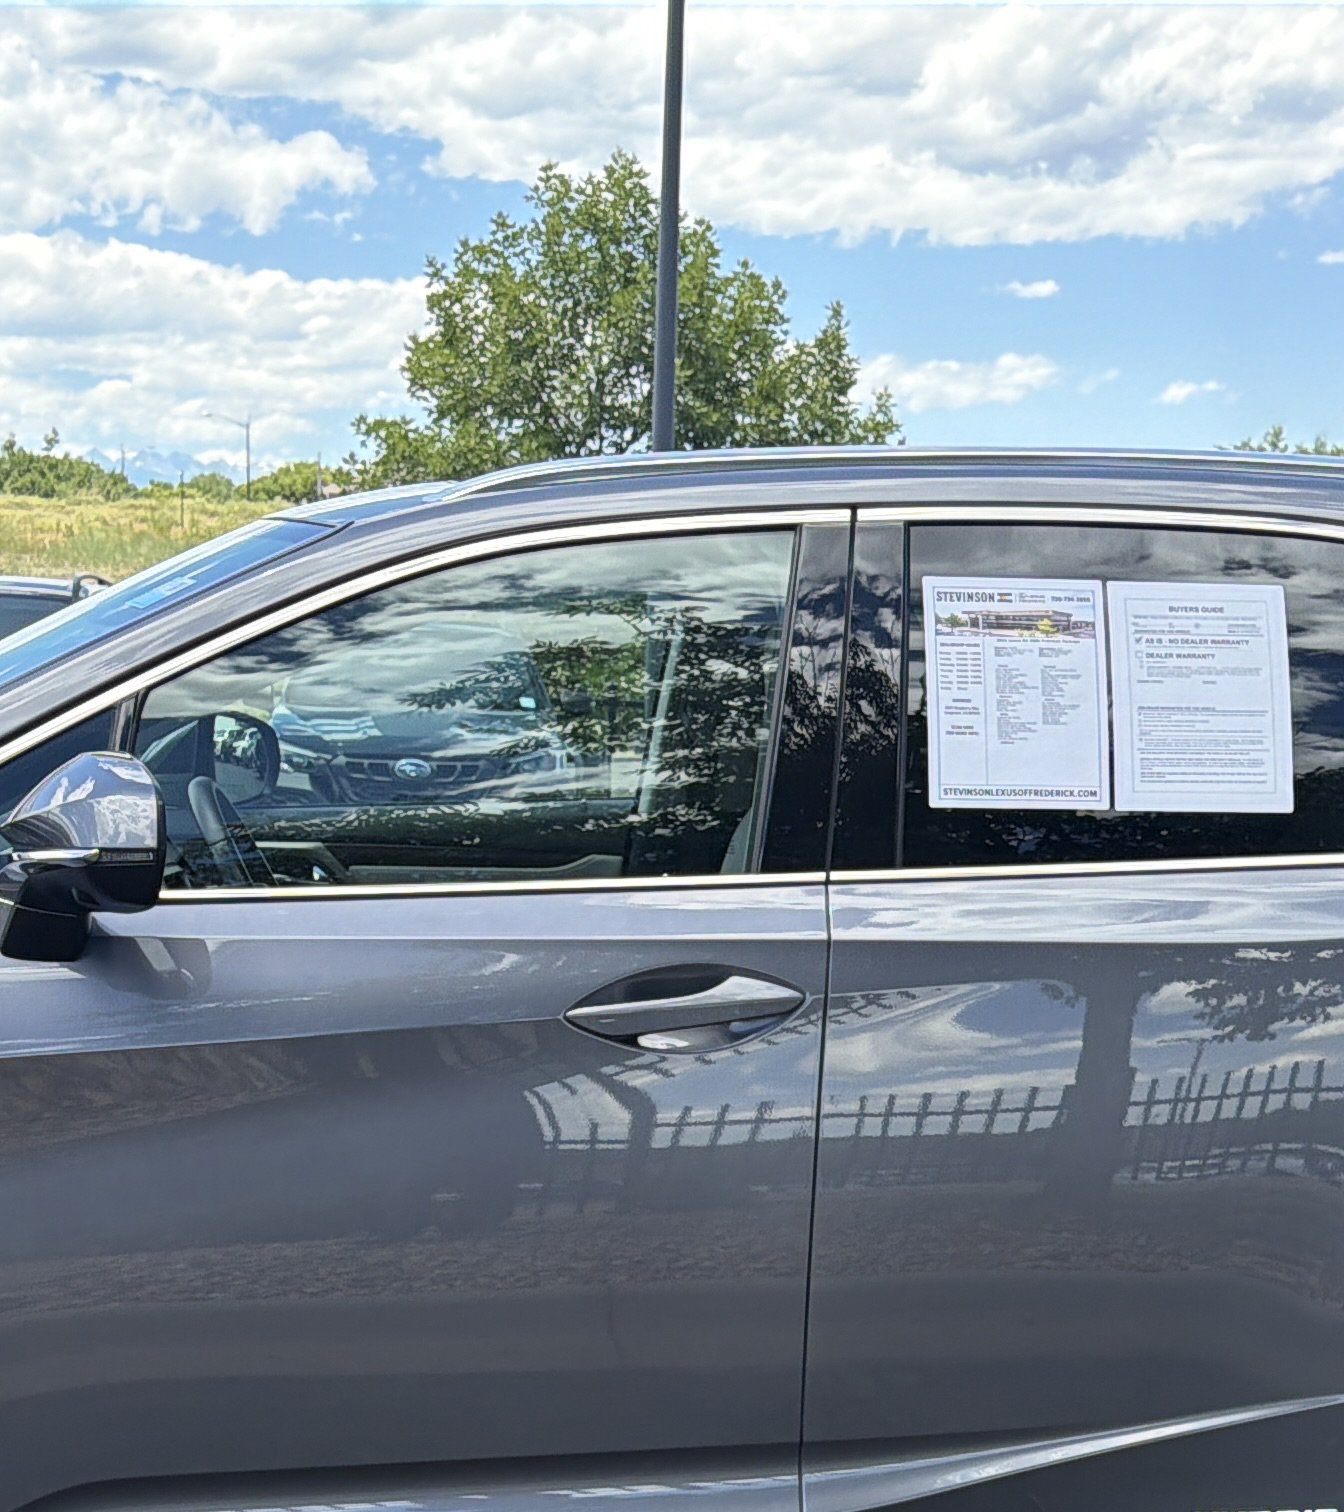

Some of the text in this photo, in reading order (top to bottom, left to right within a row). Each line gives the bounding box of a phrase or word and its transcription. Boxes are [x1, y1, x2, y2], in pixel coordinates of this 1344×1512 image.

[936, 591, 995, 603] STEVINSON
[1169, 605, 1200, 613] BUYERS
[943, 787, 1098, 798] STEVINSONLEXUSOFFREDERICK.COM
